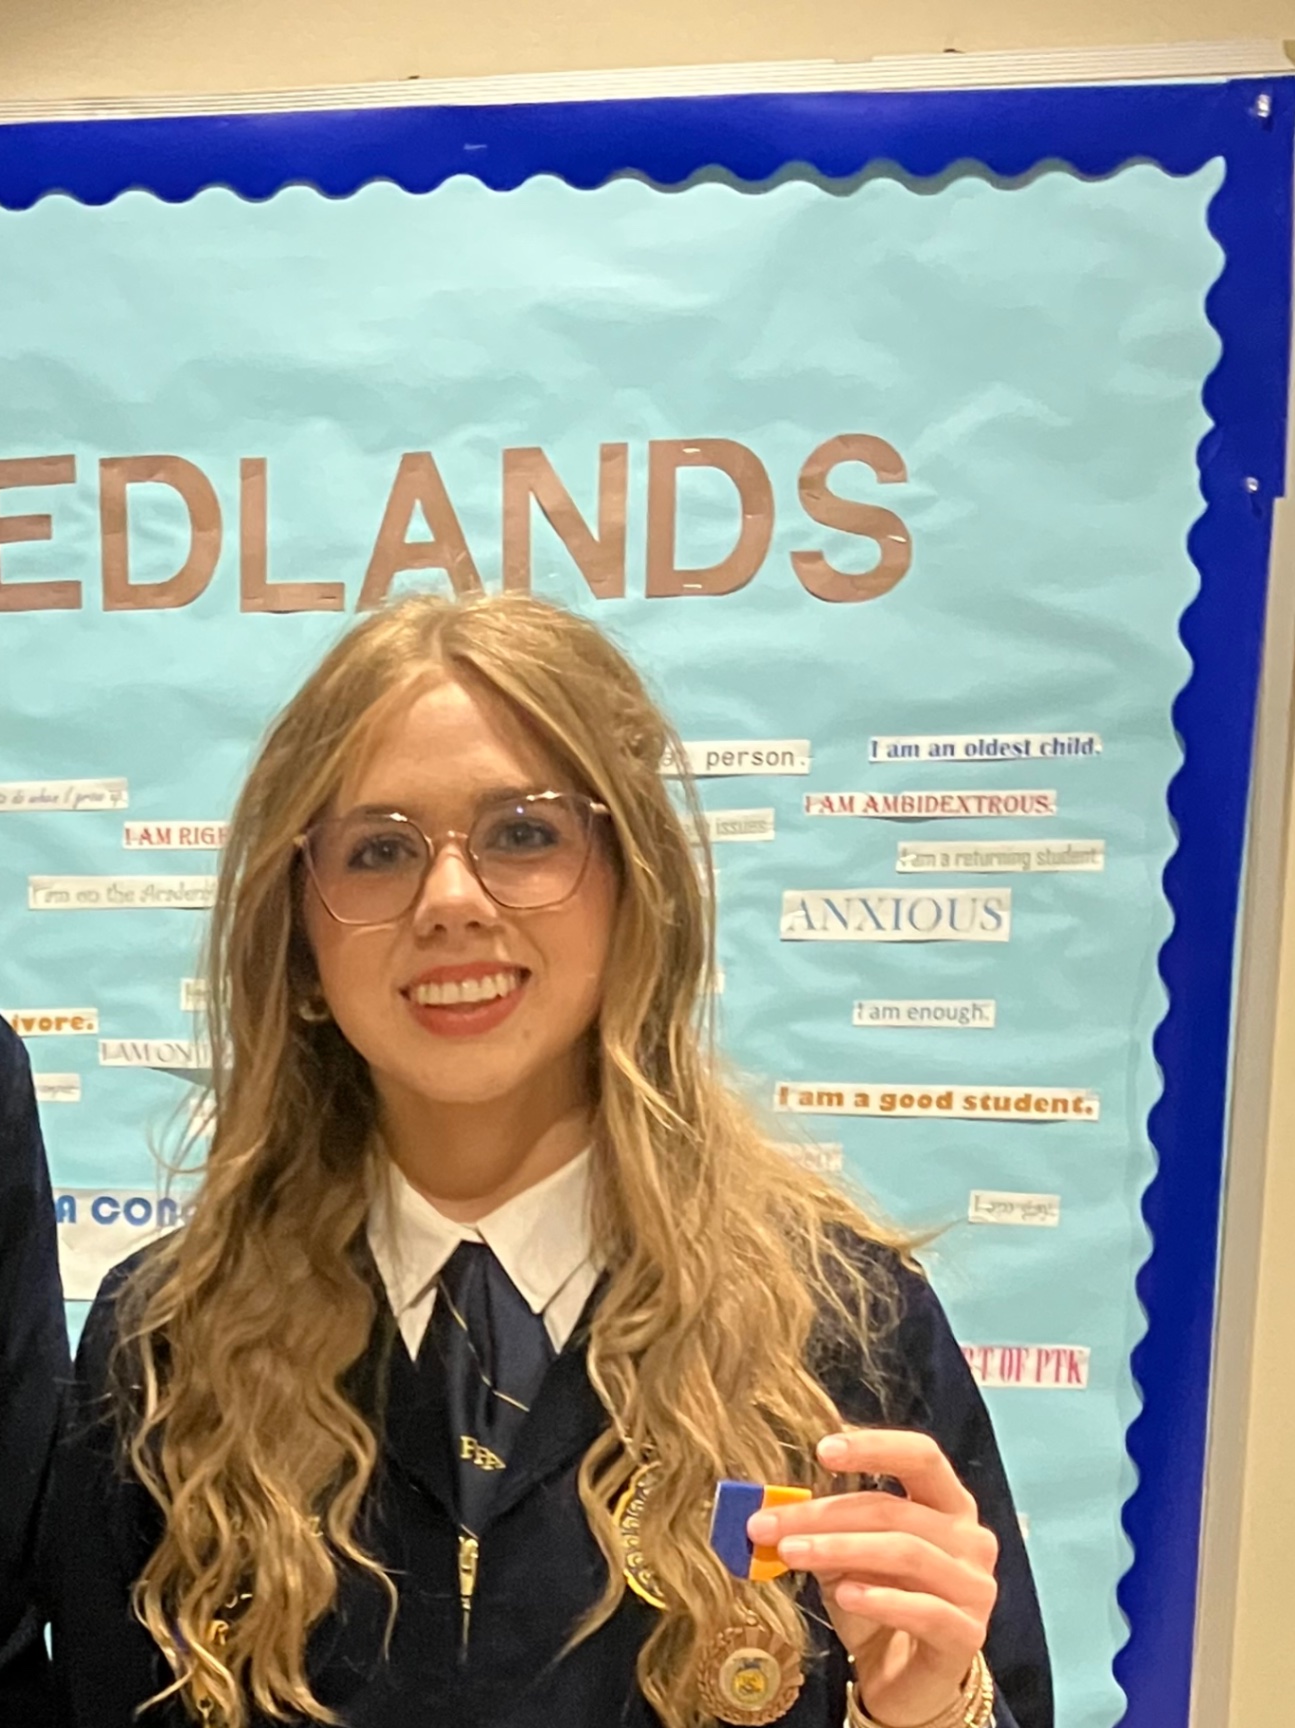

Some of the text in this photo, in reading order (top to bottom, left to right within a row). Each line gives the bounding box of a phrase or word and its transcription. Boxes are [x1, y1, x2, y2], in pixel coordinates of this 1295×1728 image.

[870, 740, 878, 758] I
[887, 743, 920, 757] am
[928, 742, 955, 757] an
[964, 738, 1032, 757] oldest
[706, 749, 806, 771] person.
[805, 795, 813, 813] I
[820, 795, 856, 814] AM
[124, 827, 132, 846] I
[138, 827, 172, 846] AM
[787, 897, 1004, 933] ANXIOUS
[857, 1002, 990, 1025] I am enough.
[779, 1086, 1094, 1115] I am a good student.
[56, 1194, 77, 1225] A
[999, 1346, 1029, 1383] OF
[1035, 1348, 1082, 1384] PTK
